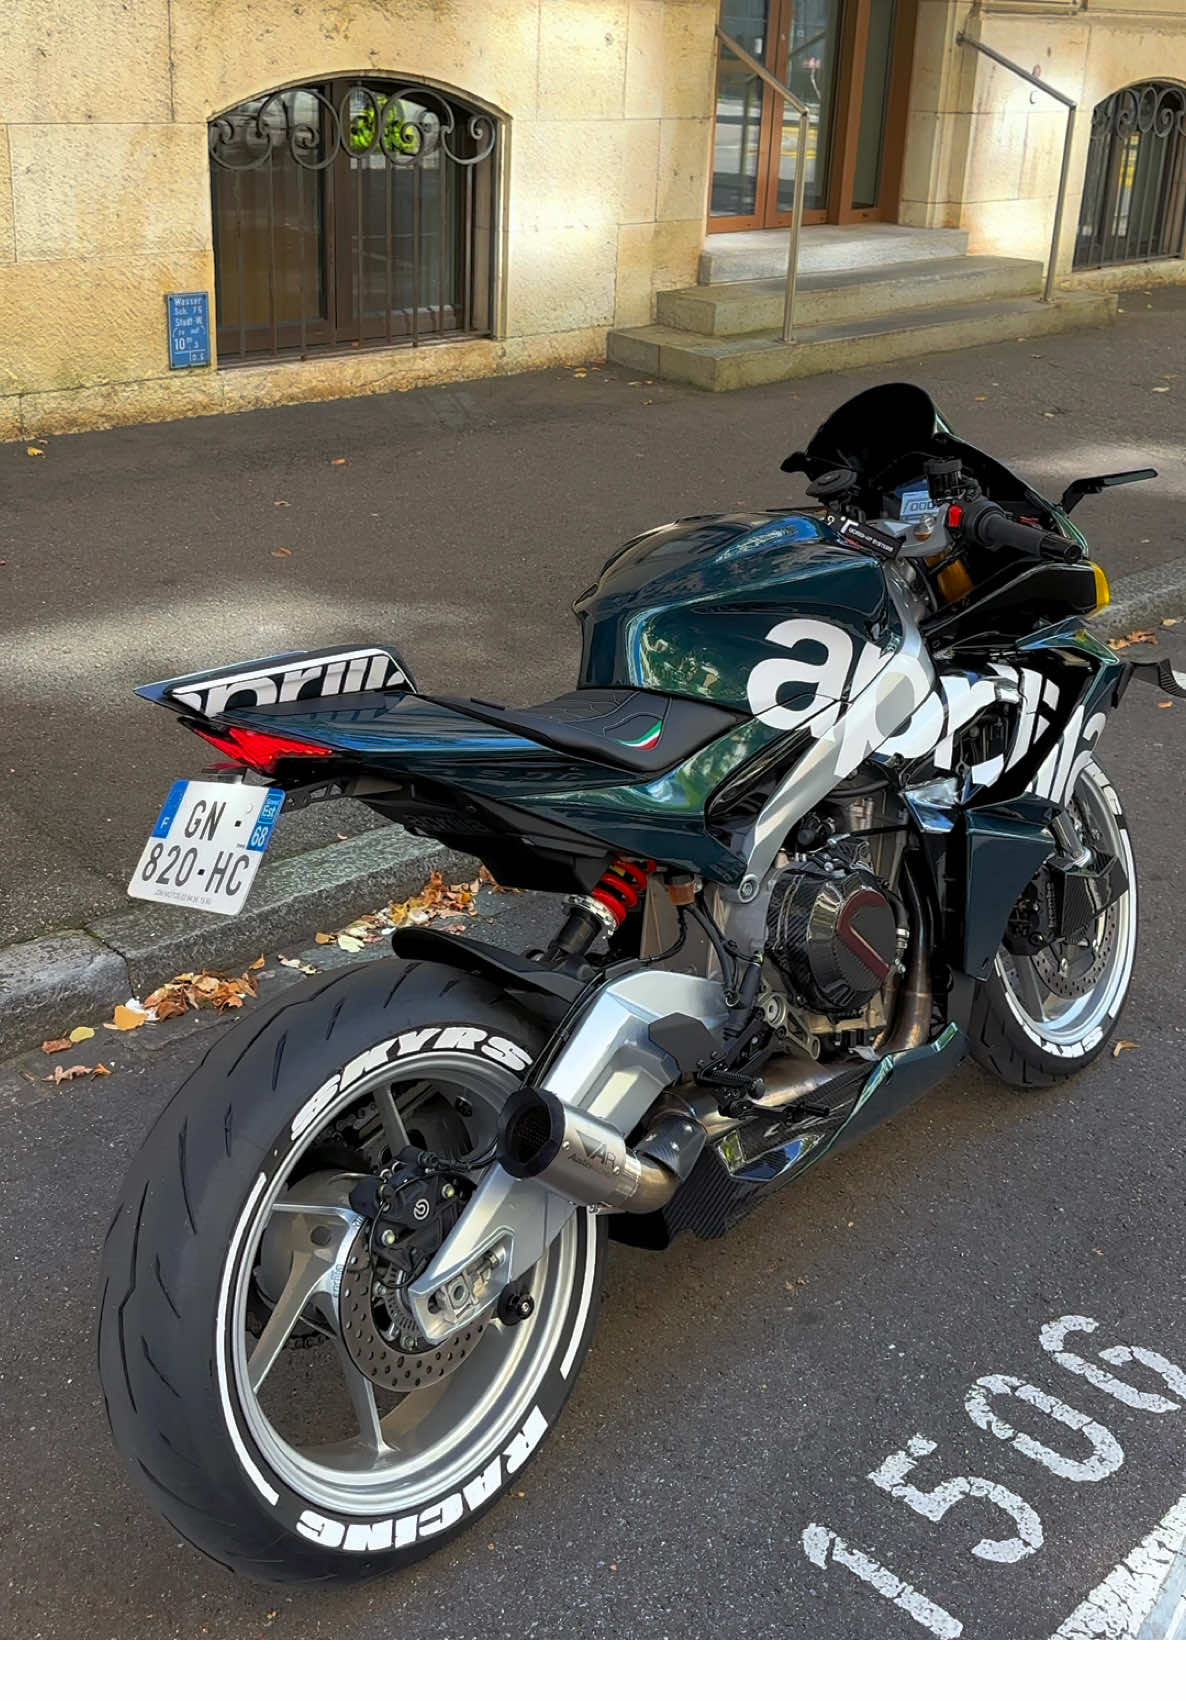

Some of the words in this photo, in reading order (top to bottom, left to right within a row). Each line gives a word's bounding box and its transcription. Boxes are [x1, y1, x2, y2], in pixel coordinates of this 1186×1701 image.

[160, 817, 170, 829] F
[184, 799, 227, 841] GN
[250, 826, 269, 848] 68
[291, 1027, 533, 1141] SKYRS
[296, 1405, 549, 1551] RACING
